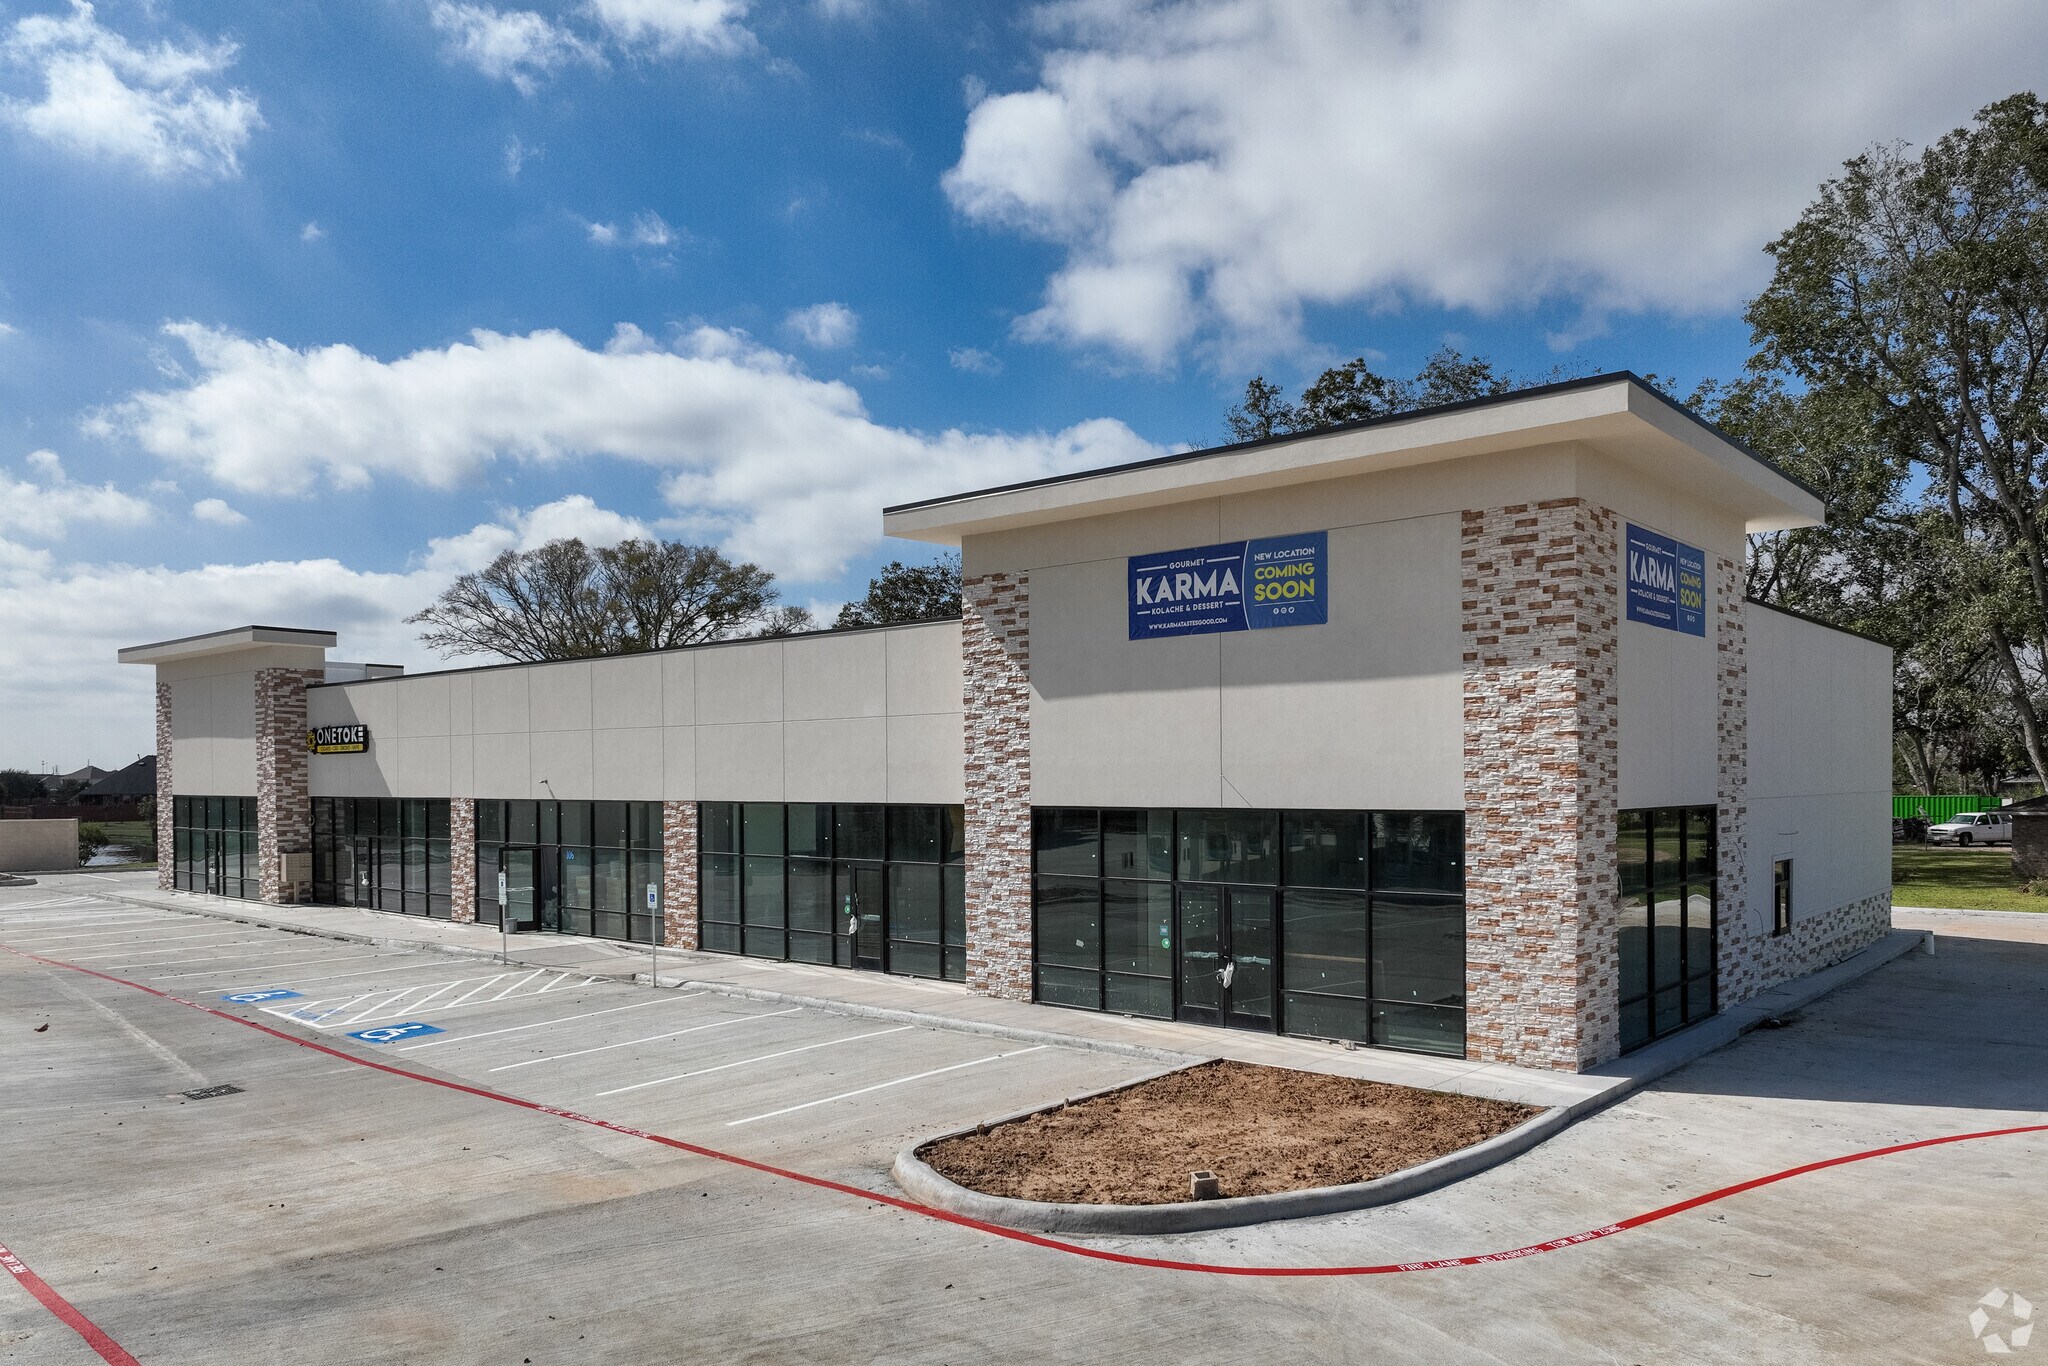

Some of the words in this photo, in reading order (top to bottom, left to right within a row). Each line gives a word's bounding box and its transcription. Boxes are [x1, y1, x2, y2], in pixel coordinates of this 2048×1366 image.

[1254, 552, 1272, 561] NEW
[1273, 547, 1315, 559] LOCATION
[1169, 558, 1205, 570] GOURMET
[1254, 562, 1315, 580] COMING
[1630, 550, 1675, 593] KARMA
[1136, 567, 1240, 605] KARMA
[1680, 571, 1702, 589] COMING
[1254, 578, 1315, 601] SOON
[1680, 587, 1702, 609] SOON
[1151, 605, 1184, 615] KOLACHE
[1192, 601, 1224, 611] DESSERT
[1148, 618, 1228, 630] WWW.KARMATASTESGOOD.COM
